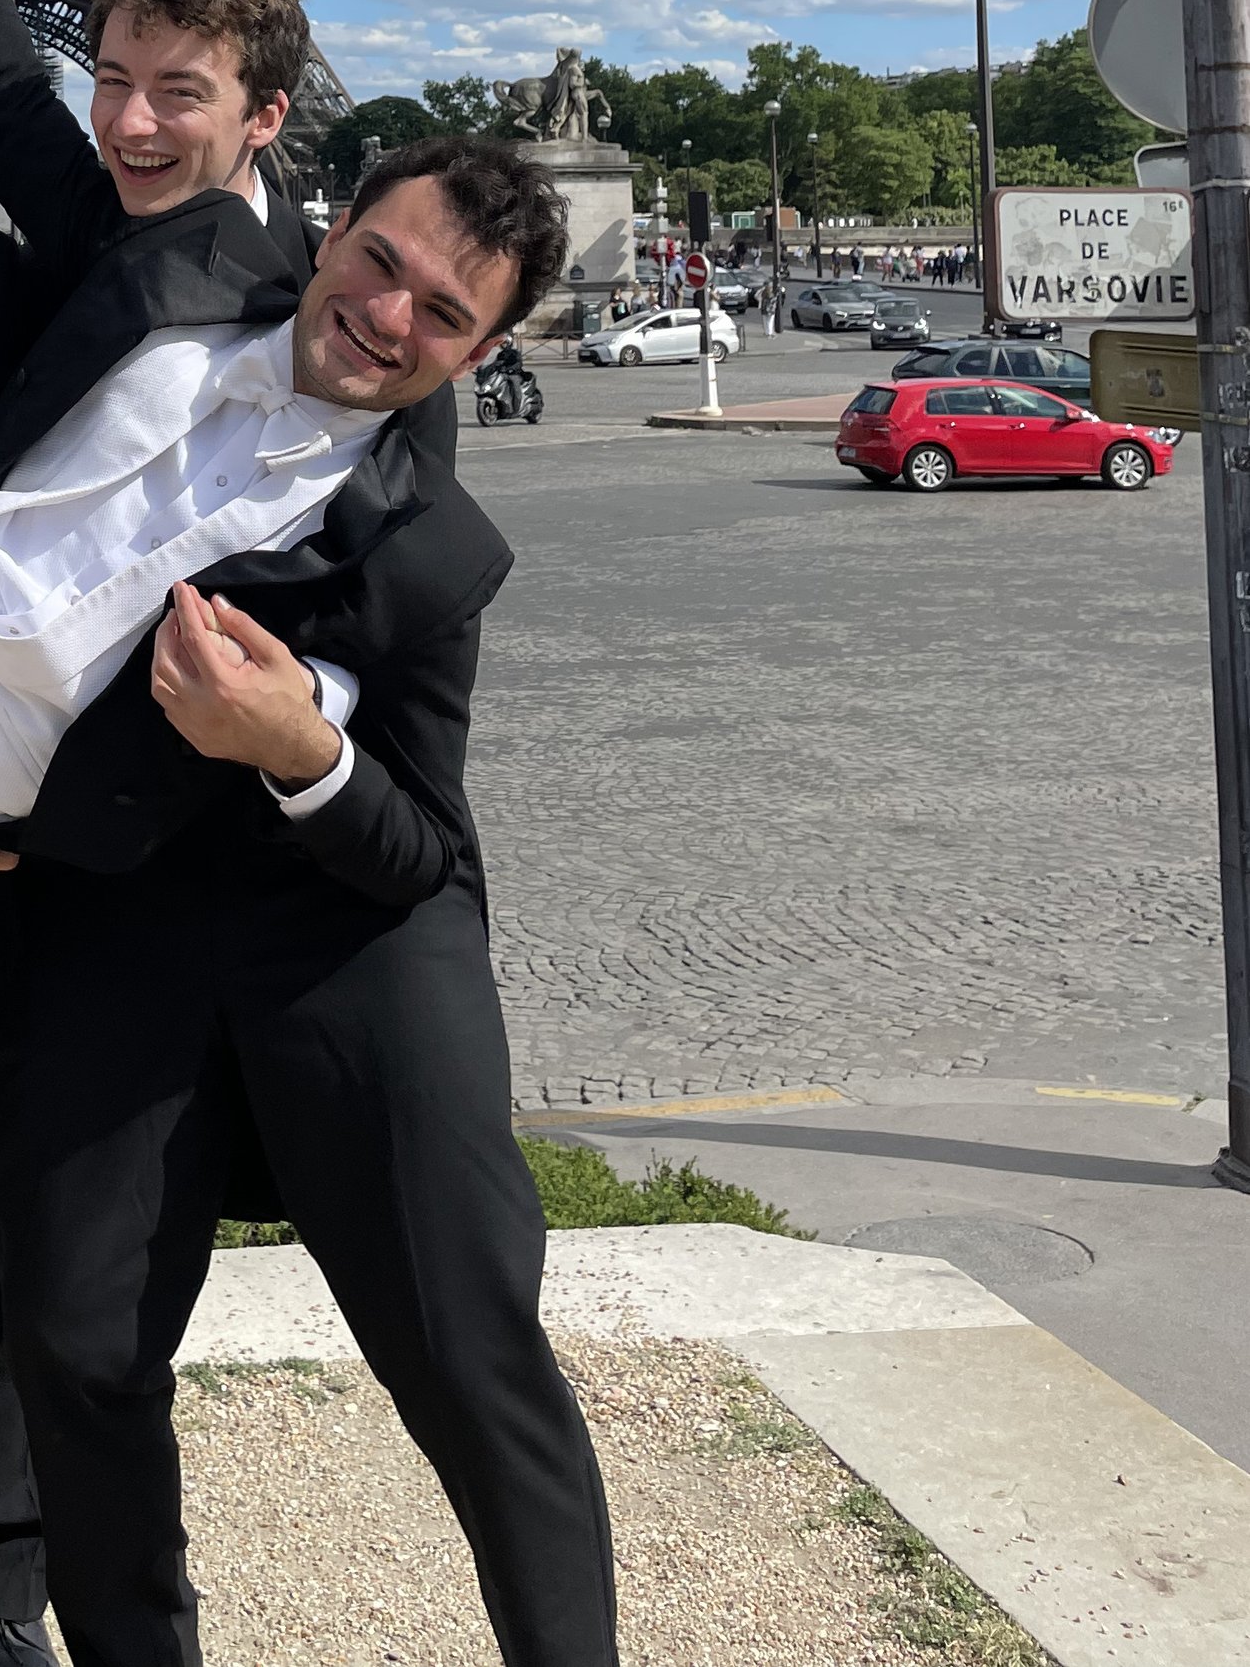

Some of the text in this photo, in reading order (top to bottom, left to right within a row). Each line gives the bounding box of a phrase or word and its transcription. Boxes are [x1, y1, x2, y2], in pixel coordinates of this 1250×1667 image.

[1059, 209, 1129, 227] PLACE
[1082, 242, 1110, 260] DE
[1007, 274, 1189, 305] VARSOVIE
